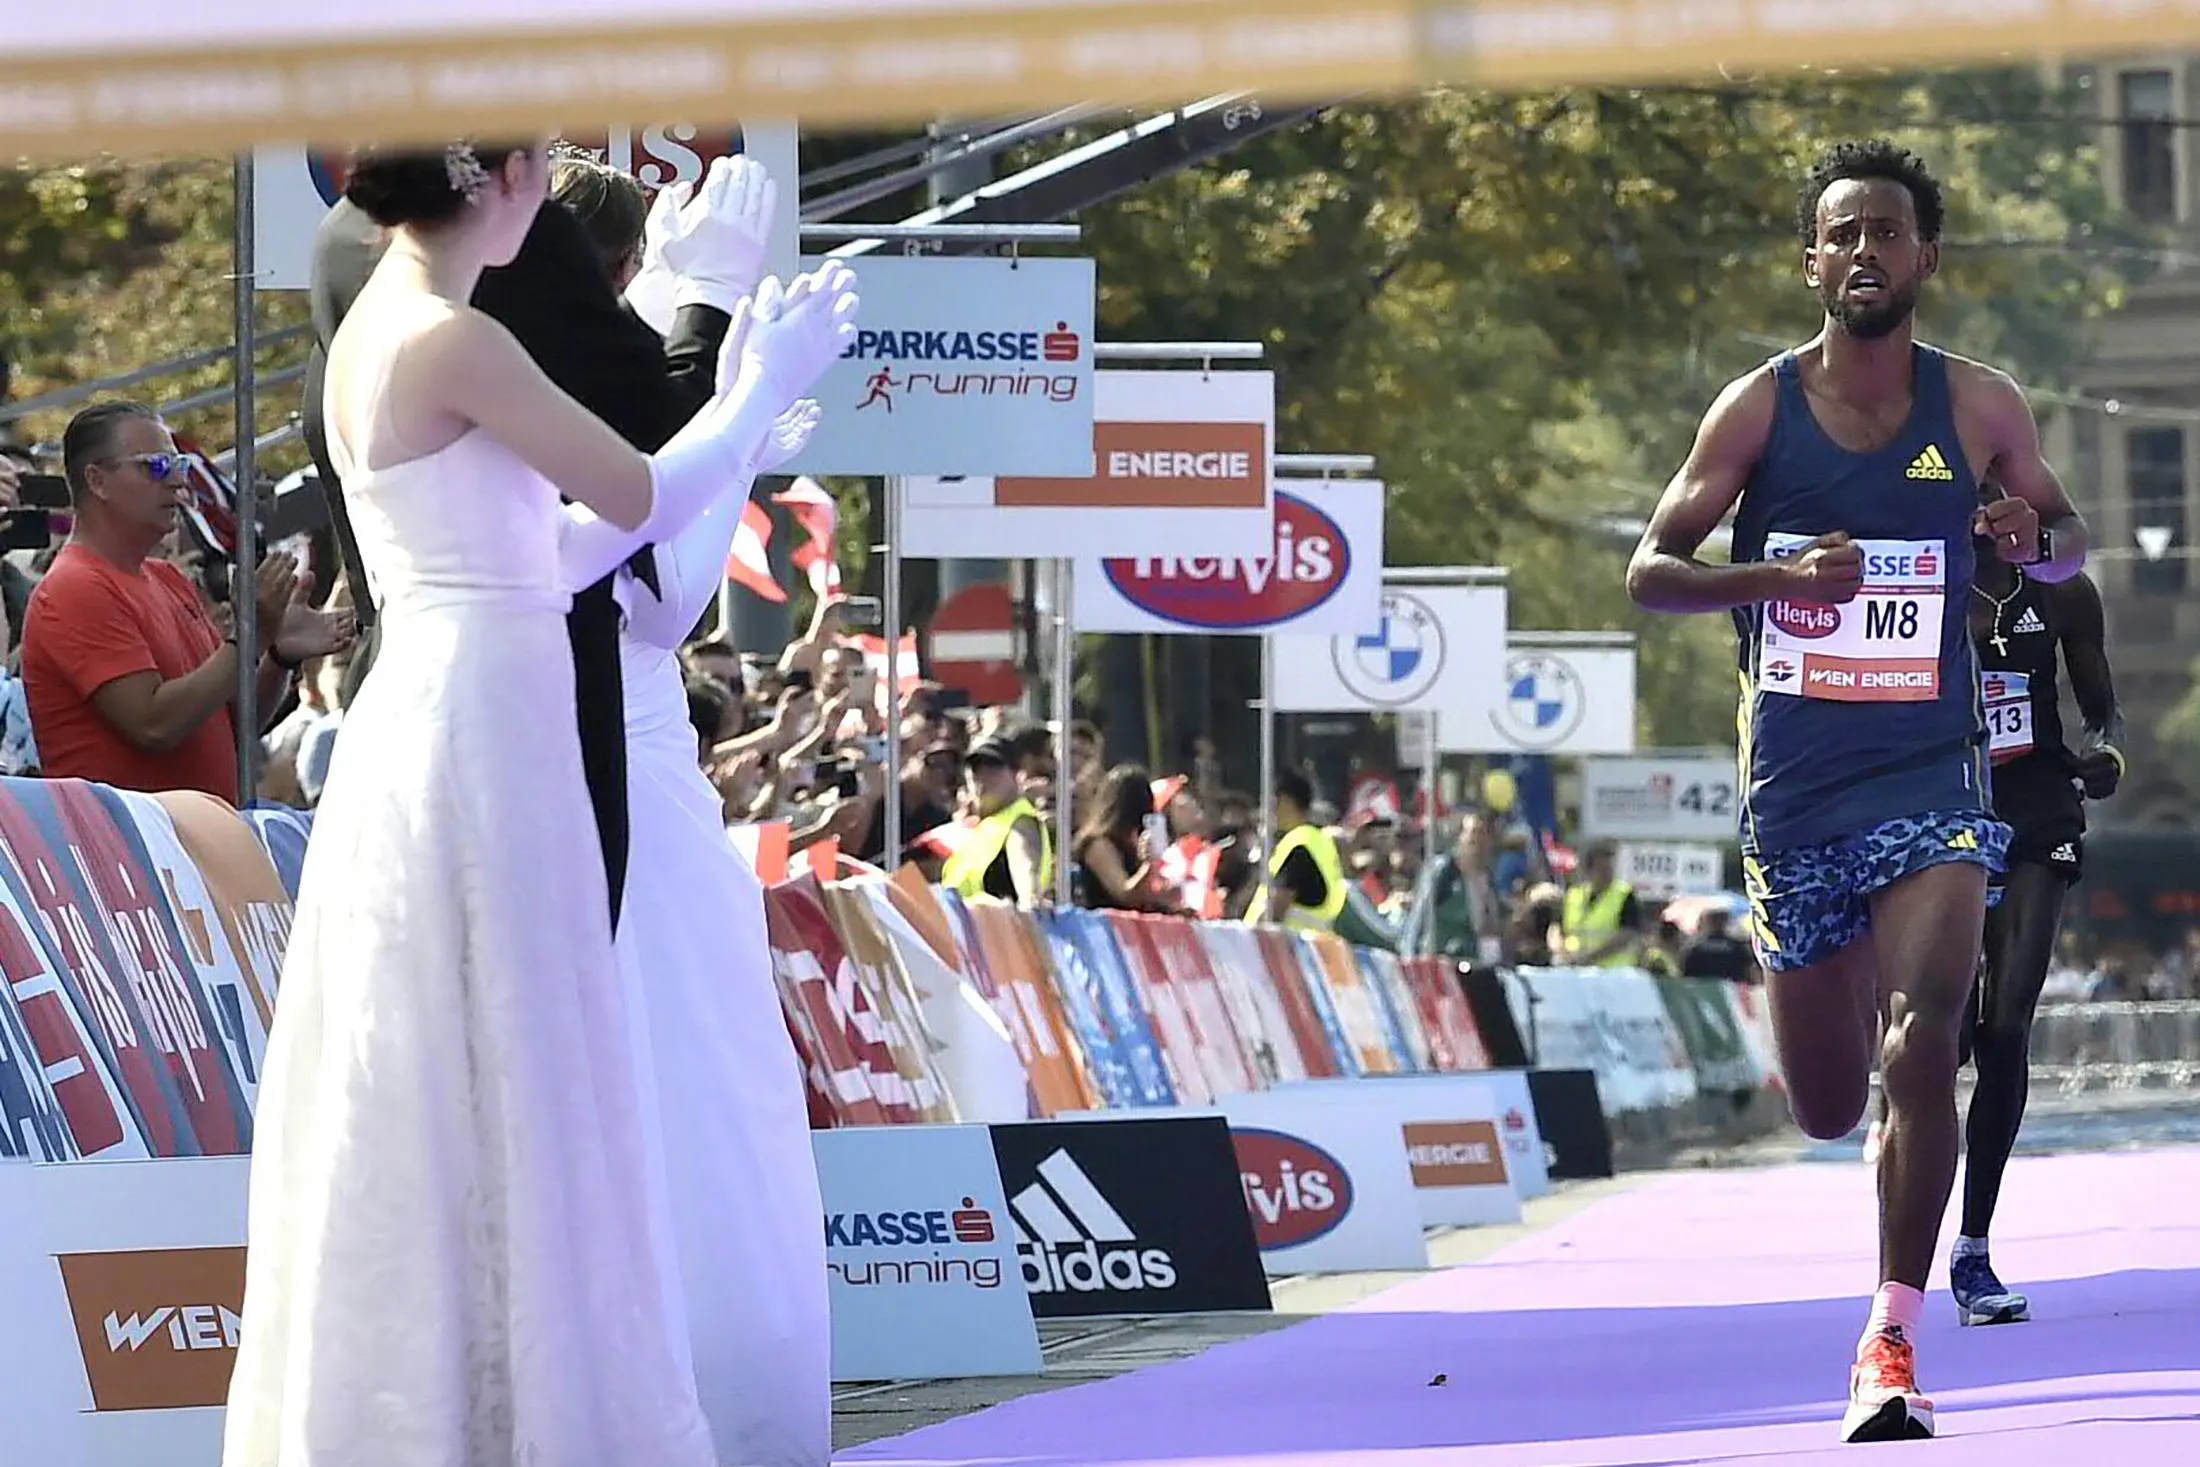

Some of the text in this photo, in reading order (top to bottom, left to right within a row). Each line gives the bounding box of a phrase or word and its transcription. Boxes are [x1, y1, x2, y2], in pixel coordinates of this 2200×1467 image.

[906, 367, 1078, 402] running
[1109, 452, 1250, 479] ENERGIE
[1905, 466, 1954, 481] adidas
[1775, 601, 1836, 631] Hervis
[1865, 601, 1919, 640] M8
[1809, 669, 1932, 688] WIEN ENERGIE
[1988, 707, 2023, 736] 13
[1679, 782, 1732, 817] 42
[1240, 1159, 1335, 1224] rvis
[824, 1211, 951, 1247] KASSE
[1018, 1239, 1178, 1294] didas
